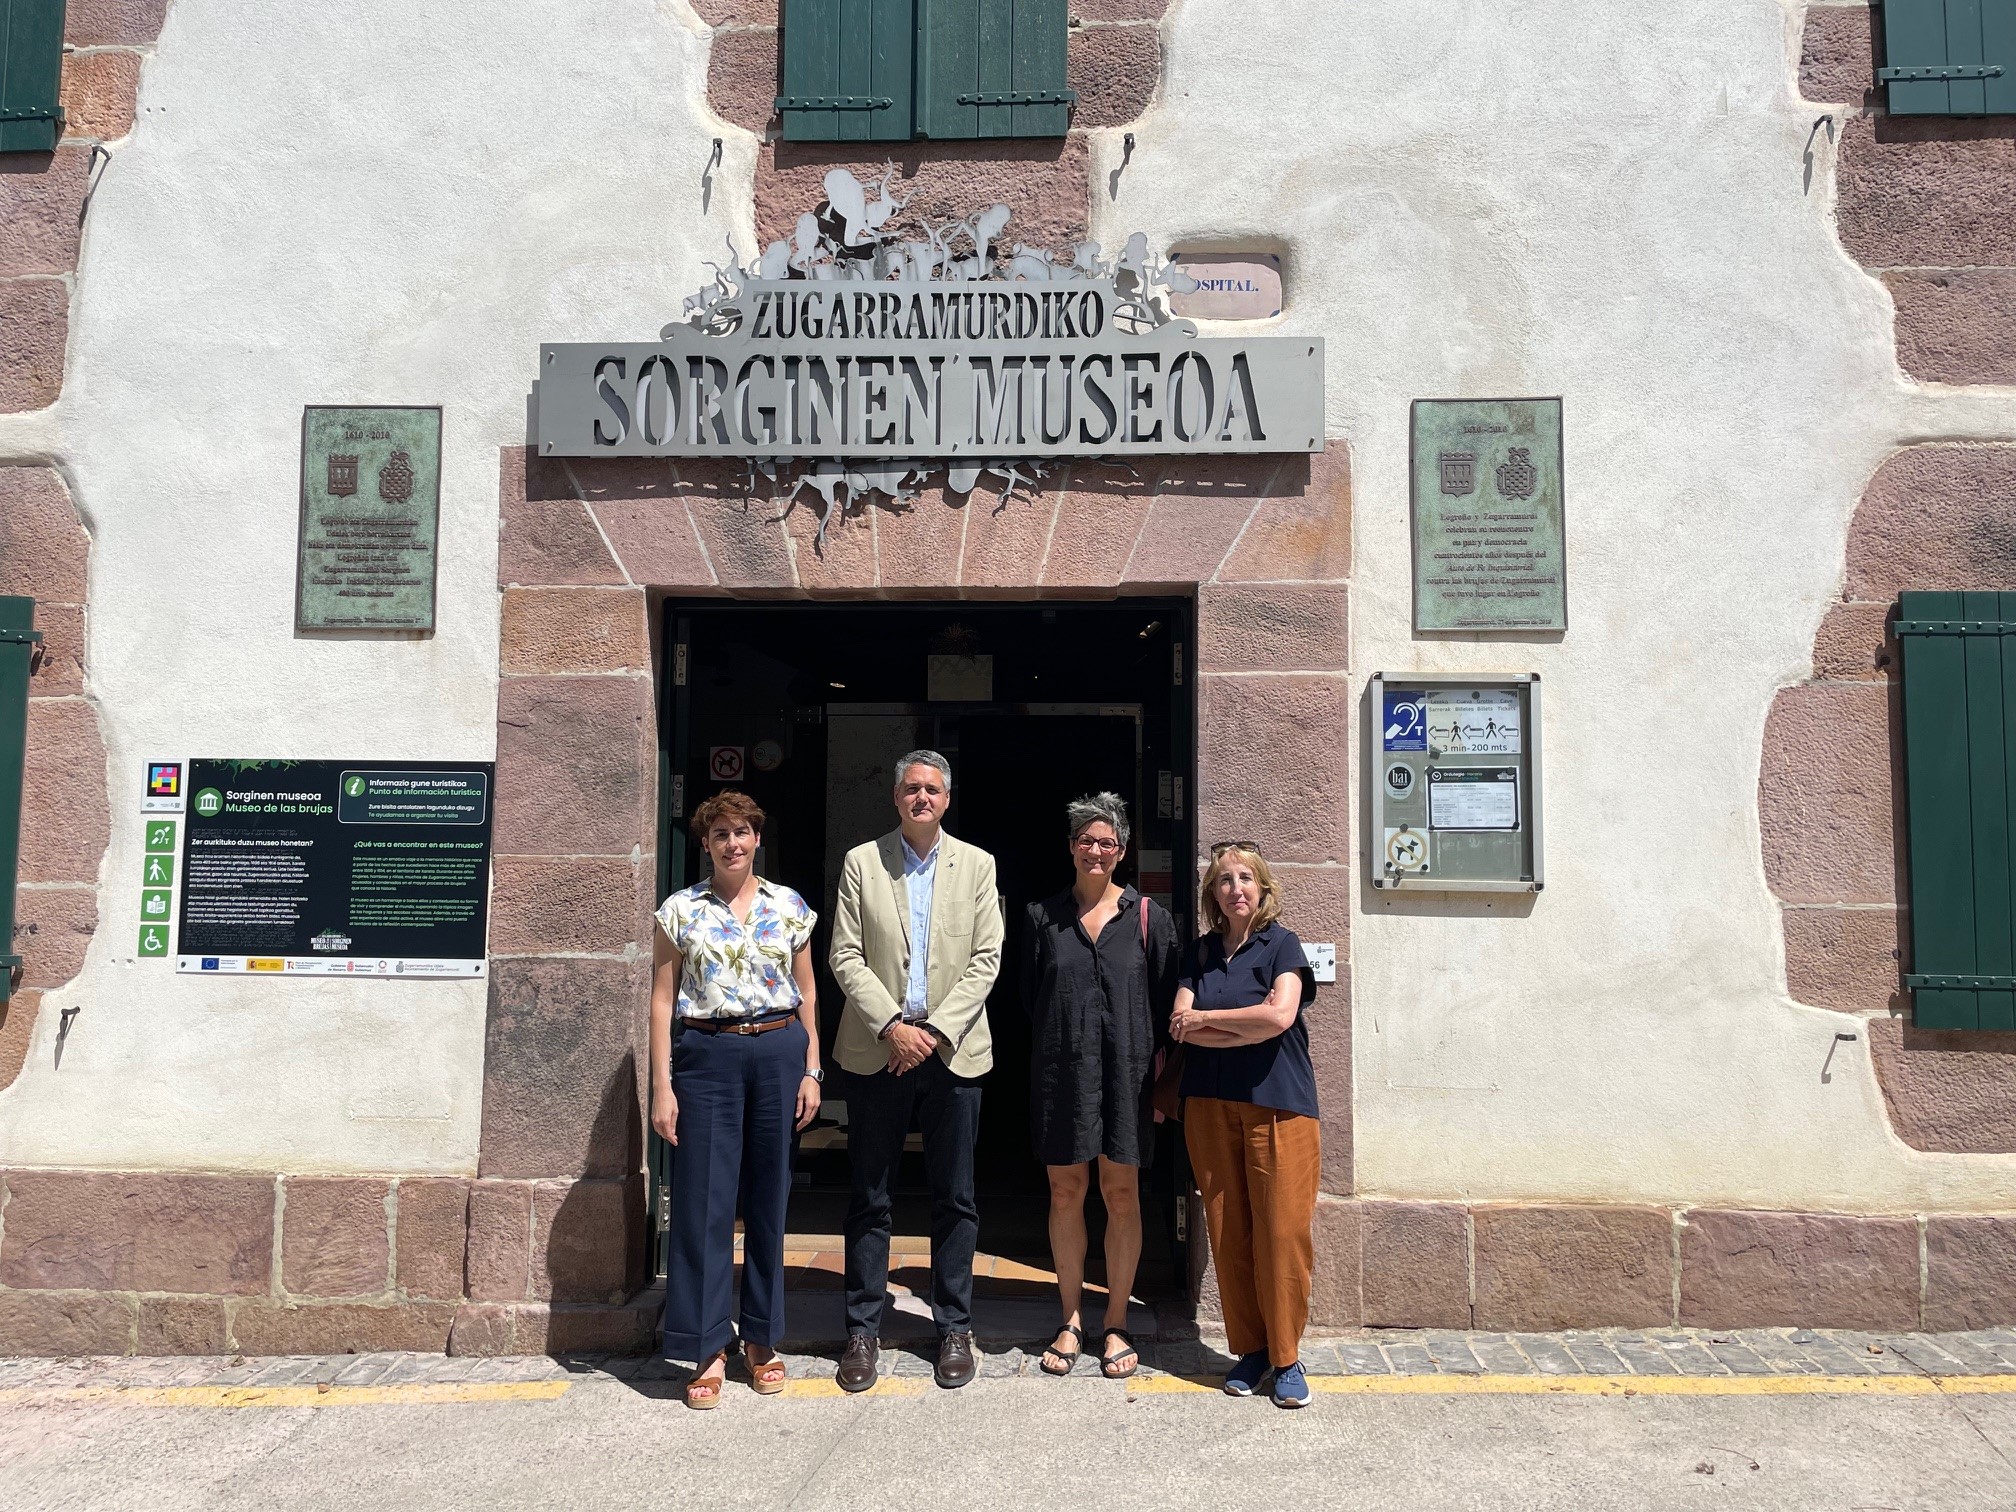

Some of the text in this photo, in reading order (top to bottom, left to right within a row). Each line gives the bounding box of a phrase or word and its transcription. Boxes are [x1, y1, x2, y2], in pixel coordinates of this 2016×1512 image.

[751, 290, 1104, 340] ZUGARRAMURDIKO
[593, 349, 1267, 447] SORGINEN MUSEOA
[345, 430, 363, 439] 1610
[1484, 538, 1527, 546] democracia
[1491, 744, 1508, 752] mts
[410, 781, 431, 789] gune
[404, 788, 450, 796] información
[226, 790, 322, 803] Sorginen museoa
[226, 803, 333, 816] Museo de las brujas
[280, 839, 314, 847] honetan?
